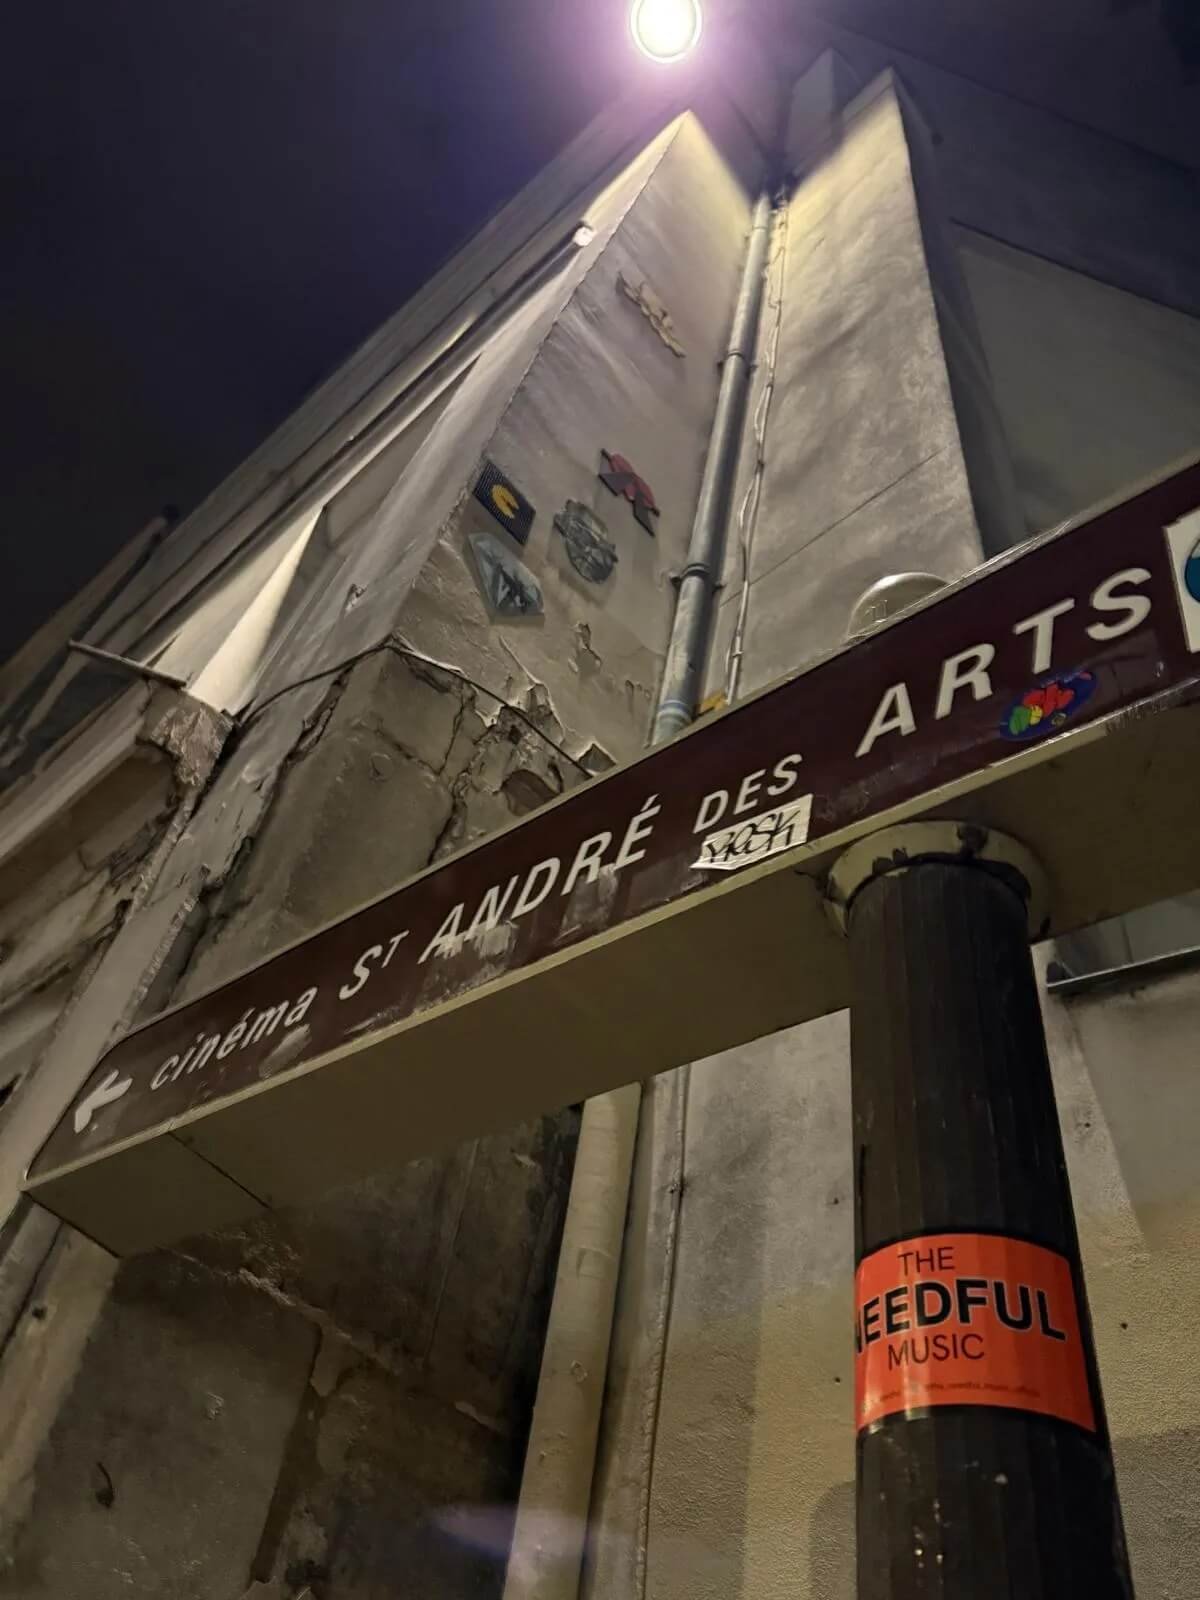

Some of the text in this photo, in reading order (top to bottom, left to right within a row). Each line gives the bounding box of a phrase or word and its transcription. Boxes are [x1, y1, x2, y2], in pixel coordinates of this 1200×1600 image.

[151, 987, 318, 1090] cinéma
[417, 794, 662, 964] ANDRÉ
[694, 754, 803, 834] DES
[855, 567, 1151, 758] ARTS
[898, 1247, 956, 1277] THE
[888, 1333, 986, 1371] MUSIC
